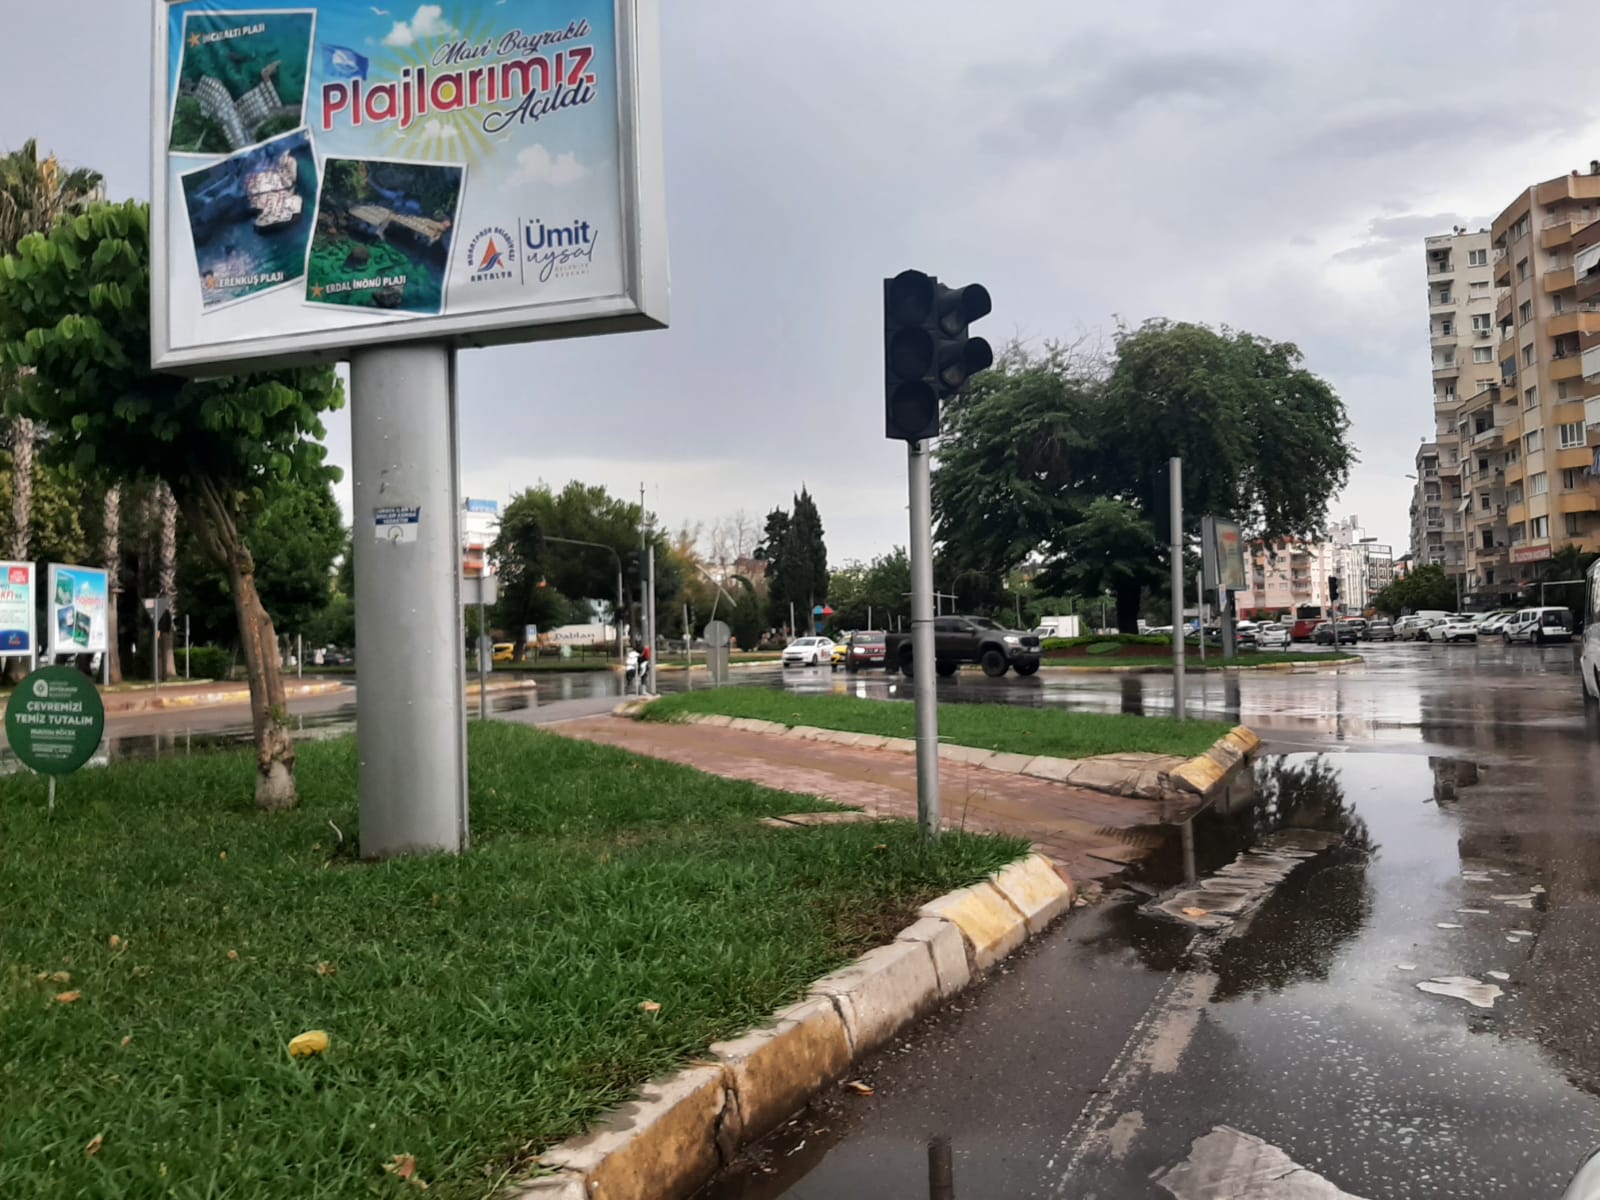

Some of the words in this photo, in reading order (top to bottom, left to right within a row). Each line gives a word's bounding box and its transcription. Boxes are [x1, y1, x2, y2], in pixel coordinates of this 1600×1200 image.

[432, 38, 491, 67] Mavi
[496, 19, 591, 57] Bayraklı
[321, 46, 595, 131] Plajlarımız
[482, 77, 596, 134] Açıldı
[525, 218, 591, 250] Ümit
[260, 272, 285, 283] PLAJI
[326, 282, 352, 294] ERDAL
[352, 275, 382, 290] İNÖNÜ
[382, 275, 407, 287] PLAJI
[470, 271, 513, 282] ANTALYA
[26, 700, 83, 712] ÇEVREMİZİ
[15, 713, 46, 725] TEMİZ
[48, 714, 94, 726] TUTALIM
